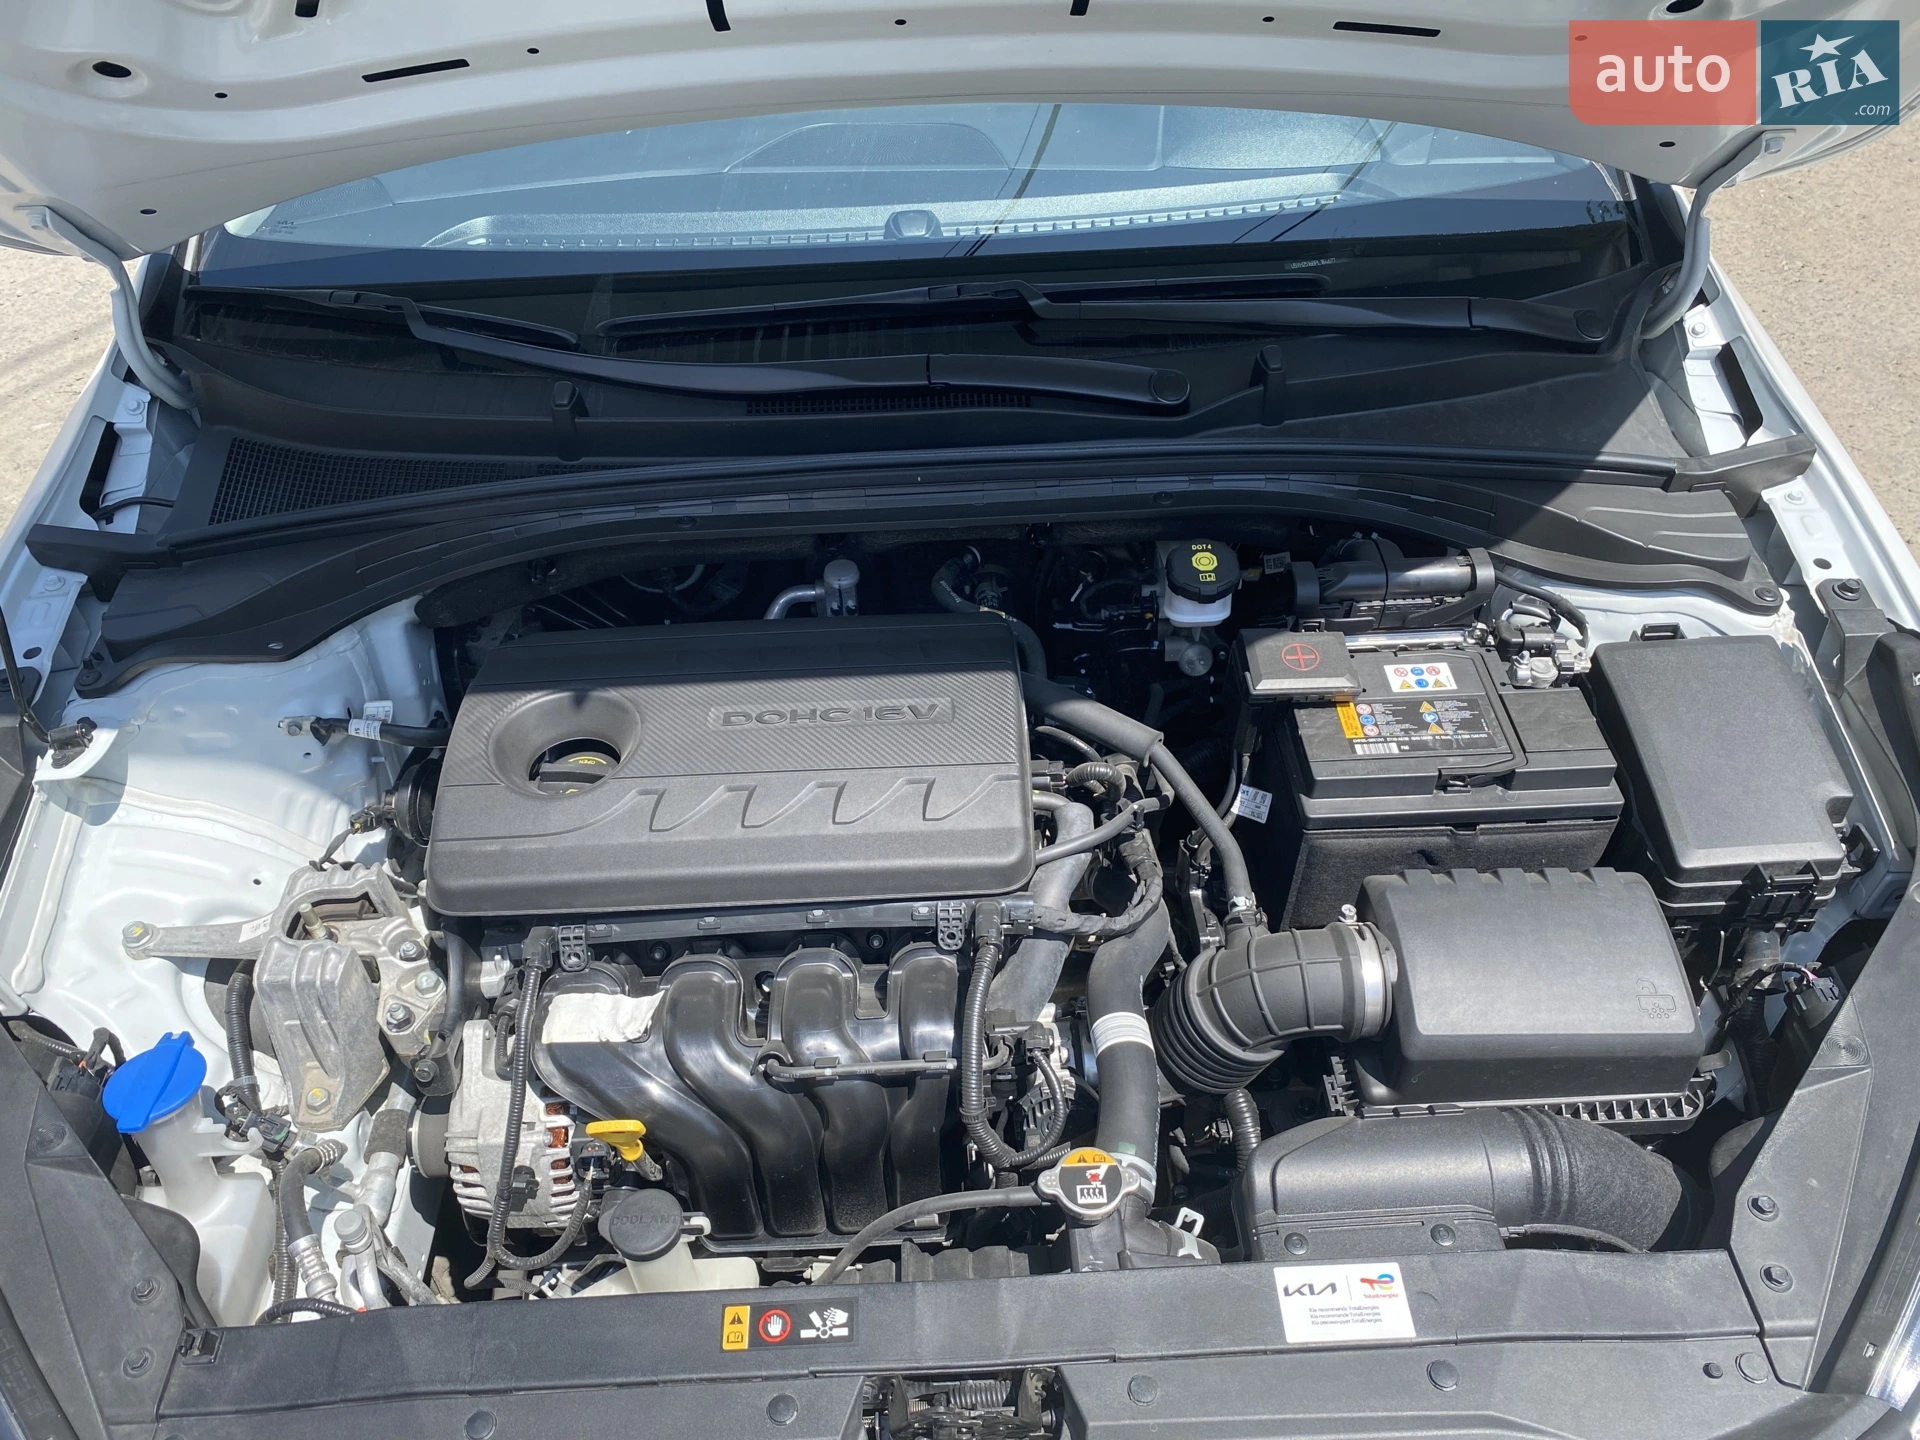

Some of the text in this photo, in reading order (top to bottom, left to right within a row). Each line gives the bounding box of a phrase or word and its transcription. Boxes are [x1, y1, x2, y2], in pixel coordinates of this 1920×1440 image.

[722, 703, 939, 726] DOHC 16V
[612, 1214, 679, 1226] COOLANT
[1283, 1282, 1338, 1297] KIA
